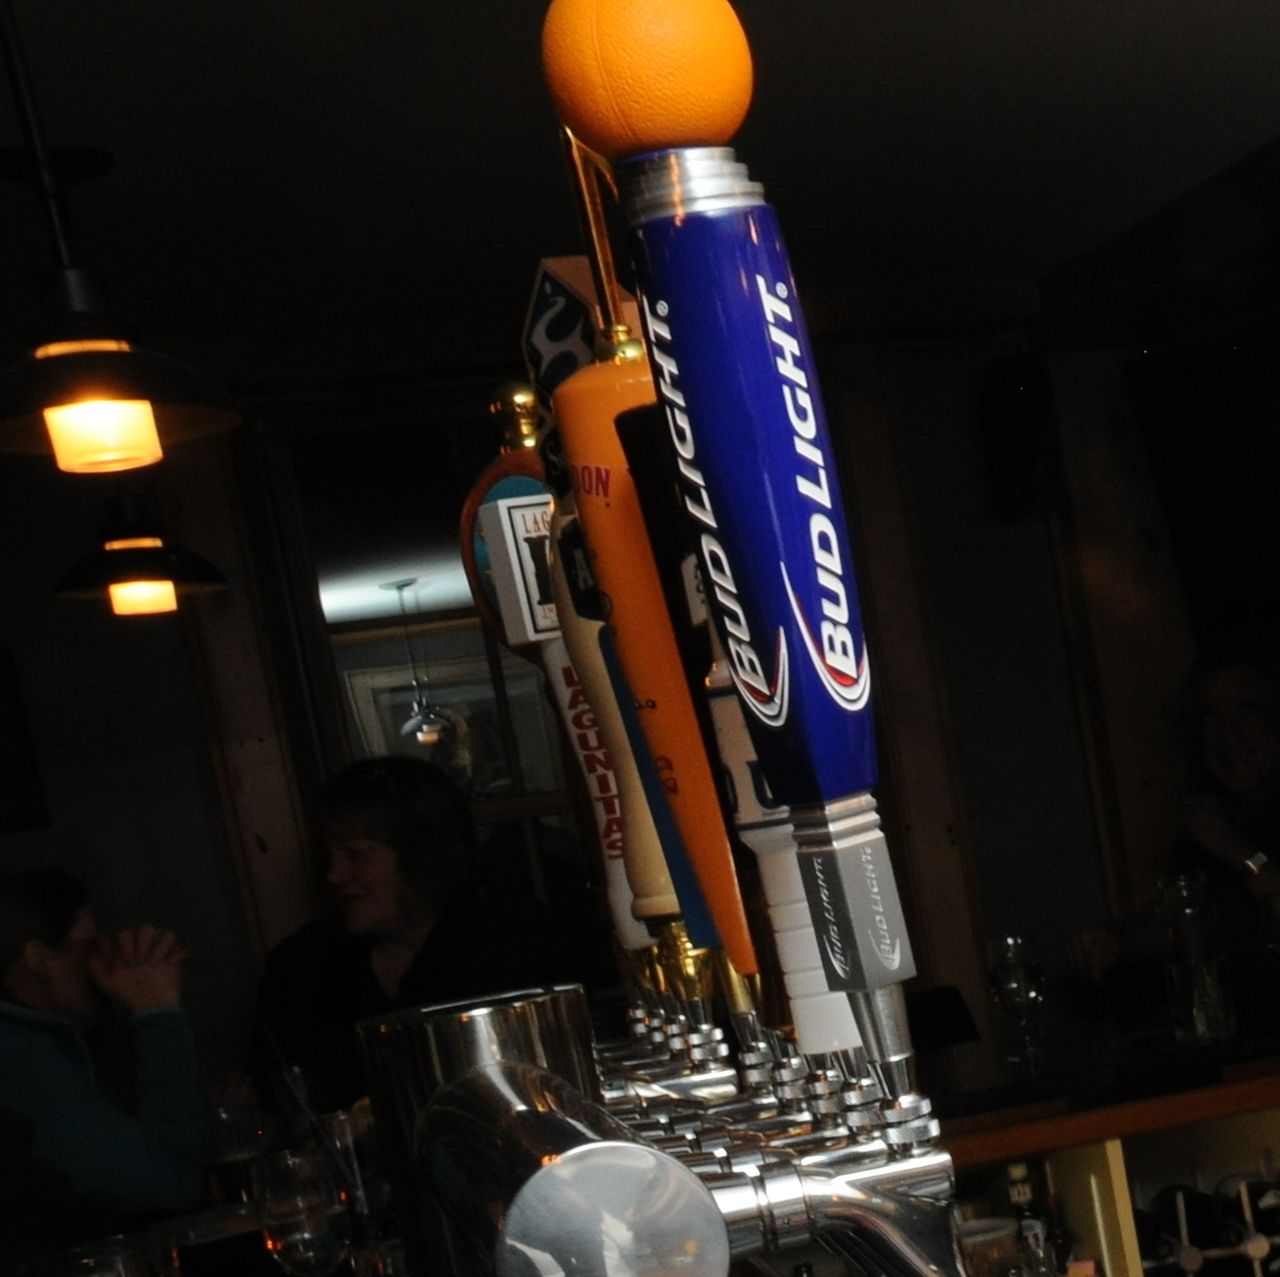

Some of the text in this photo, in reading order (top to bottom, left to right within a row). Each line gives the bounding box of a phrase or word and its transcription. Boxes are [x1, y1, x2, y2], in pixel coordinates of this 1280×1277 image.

[642, 293, 772, 696] BUD LIGHT
[756, 273, 858, 680] BUD LIGHT
